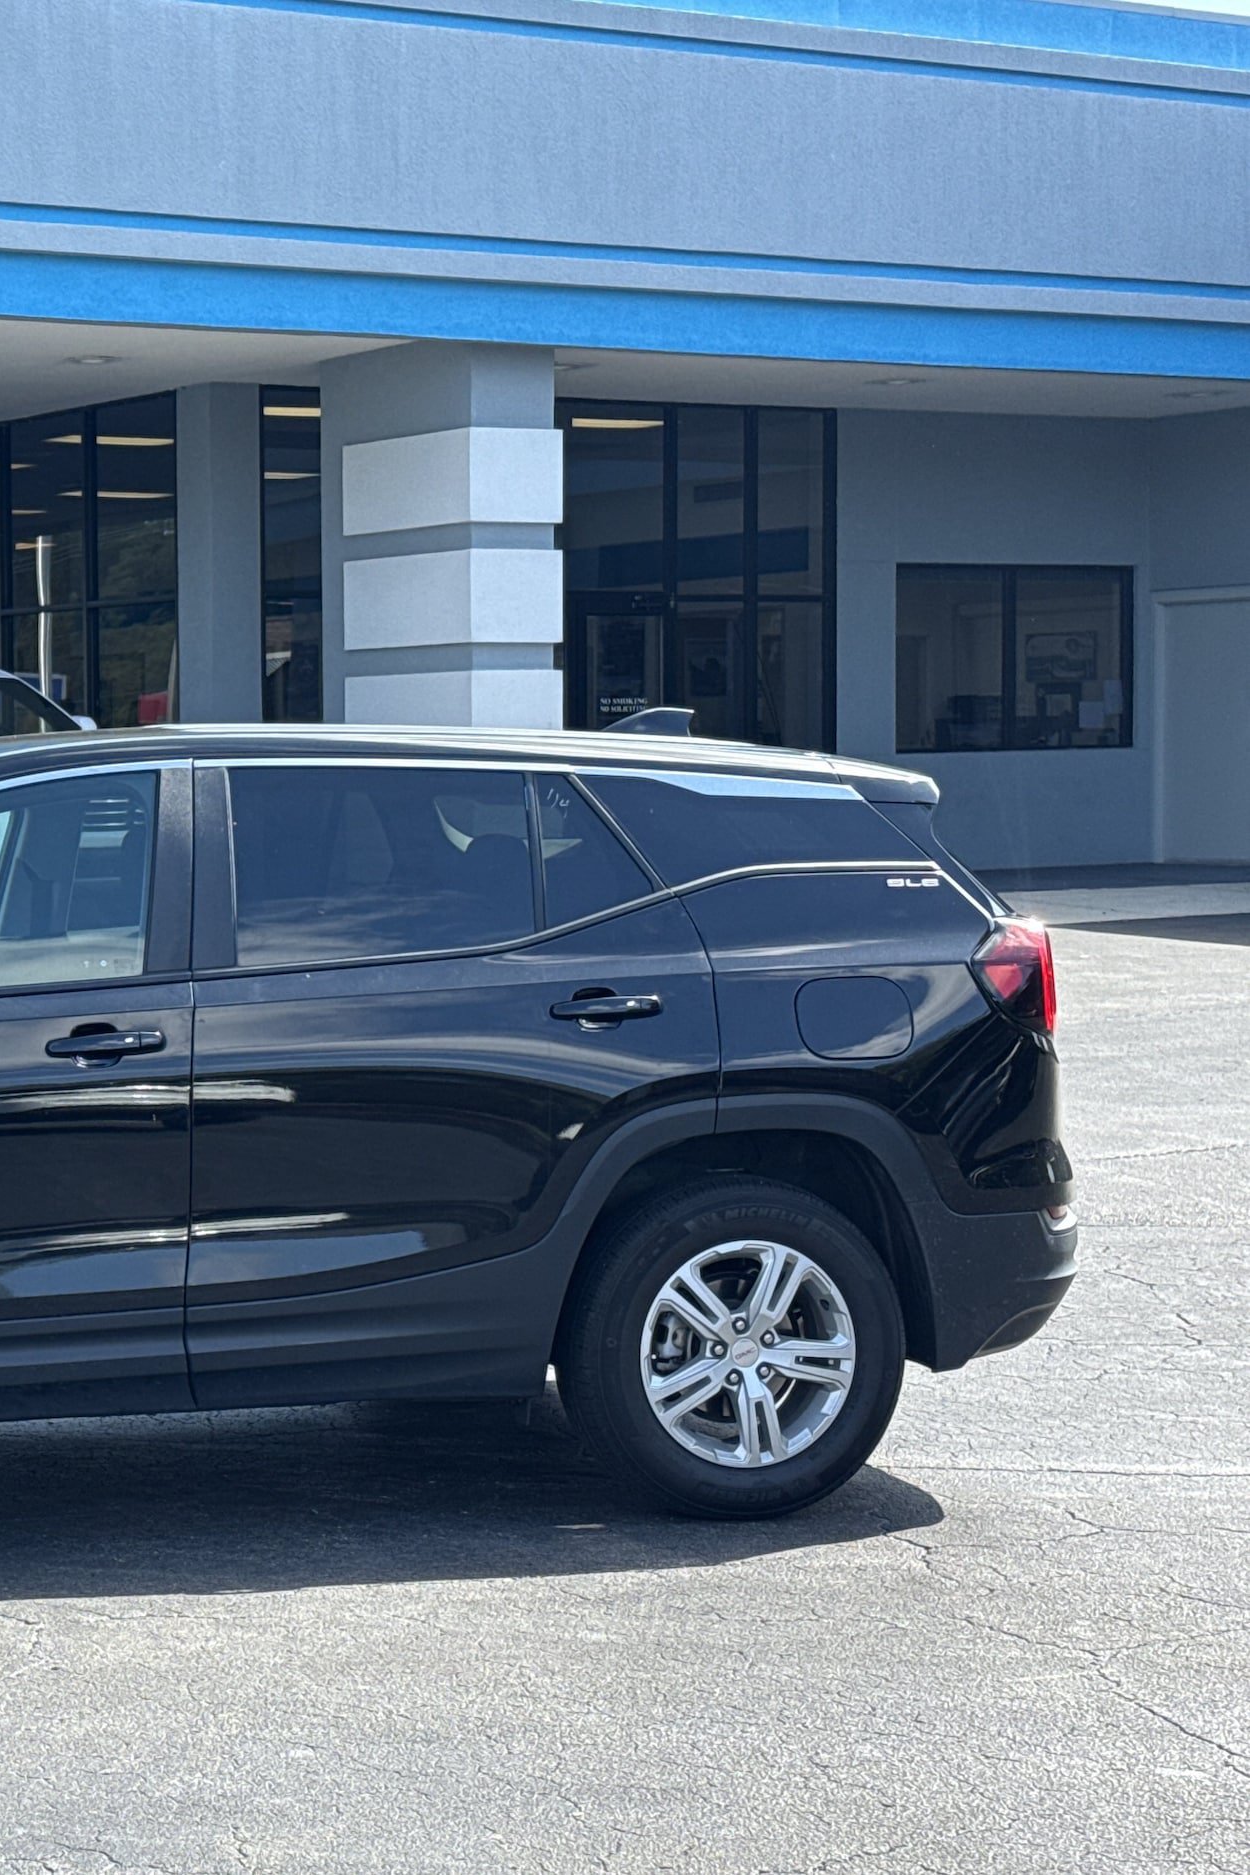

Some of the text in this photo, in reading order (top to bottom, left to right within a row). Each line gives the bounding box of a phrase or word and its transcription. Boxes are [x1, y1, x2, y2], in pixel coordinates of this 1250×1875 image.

[600, 697, 648, 705] NO SMOKING
[724, 1206, 810, 1227] MICHELIN
[735, 1346, 757, 1359] GMC
